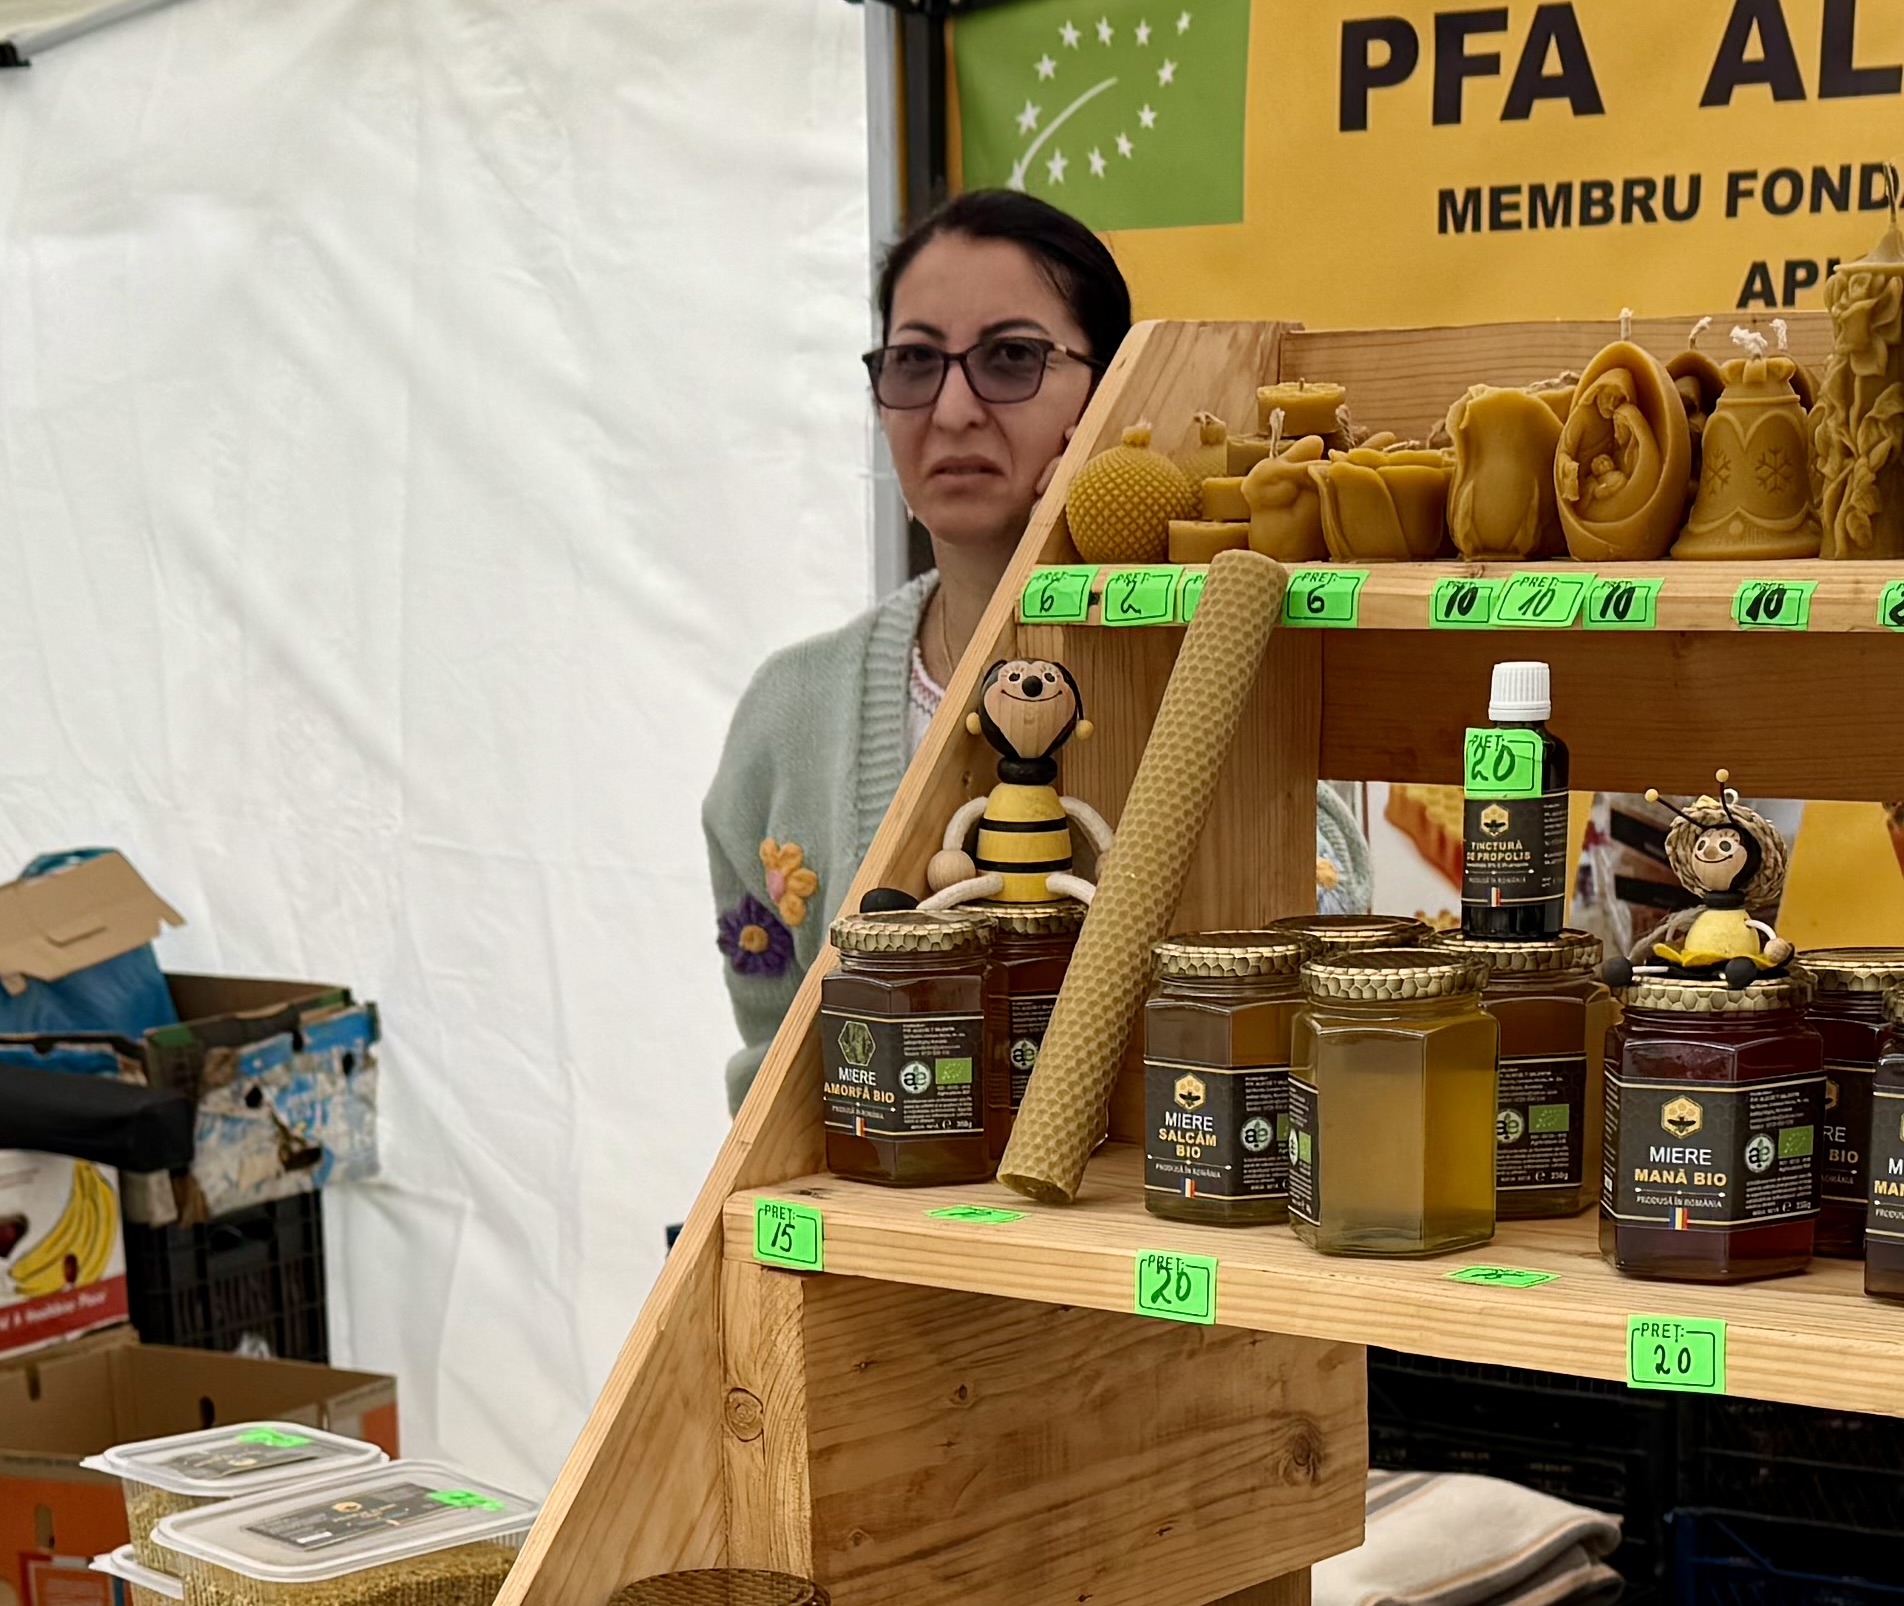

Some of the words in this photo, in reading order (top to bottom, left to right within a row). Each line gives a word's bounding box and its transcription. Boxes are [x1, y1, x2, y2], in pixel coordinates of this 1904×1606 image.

[1339, 2, 1604, 132] PFA
[1436, 172, 1700, 236] MEMBRU
[1040, 581, 1060, 611] 6
[1120, 579, 1141, 614] 2
[1308, 585, 1325, 612] 6
[1444, 586, 1478, 618] 10
[1518, 587, 1555, 617] 10
[1600, 586, 1636, 619] 10
[1746, 588, 1786, 620] 10
[1471, 741, 1517, 782] 20
[838, 1066, 876, 1086] MIERE
[1164, 1112, 1213, 1132] MIERE
[1176, 1144, 1201, 1159] BIO
[1649, 1146, 1712, 1166] MIERE
[1693, 1171, 1727, 1187] BIO
[770, 1224, 793, 1252] 15
[1151, 1269, 1193, 1306] 20
[1654, 1344, 1692, 1375] 20
